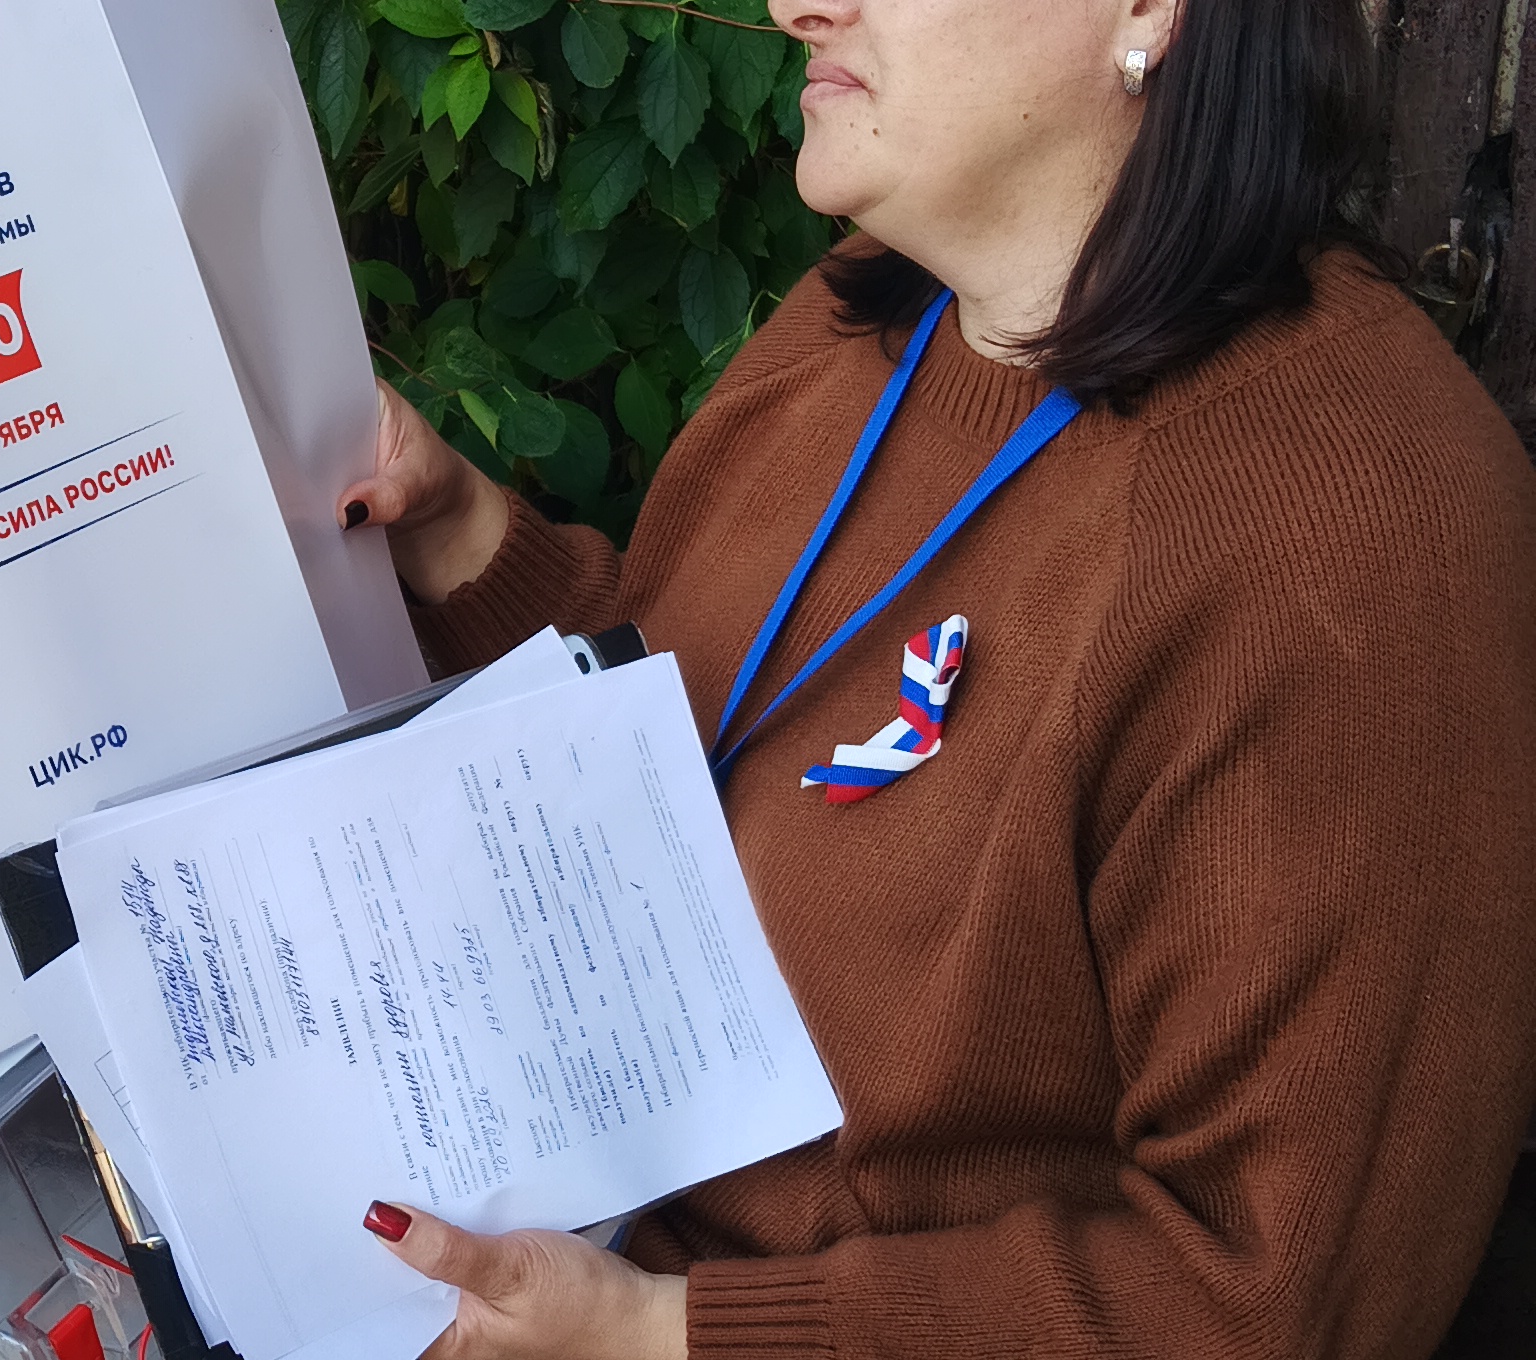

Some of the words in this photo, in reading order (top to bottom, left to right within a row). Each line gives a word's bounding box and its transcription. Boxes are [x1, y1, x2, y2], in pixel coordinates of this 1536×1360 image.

[65, 444, 175, 509] РОССИИ!
[29, 723, 129, 788] ЦИК.РФ
[516, 747, 532, 781] округу
[456, 765, 479, 813] депутатов
[467, 762, 489, 815] Федерации
[365, 815, 378, 834] для
[502, 799, 518, 833] округу
[307, 835, 317, 849] по
[475, 820, 494, 860] выборах
[486, 823, 511, 878] Российской
[534, 802, 565, 881] избирательному
[311, 850, 337, 911] голосования
[373, 838, 397, 893] помещения
[491, 867, 501, 880] на
[517, 843, 548, 922] избирательному
[581, 847, 599, 888] членами
[331, 911, 344, 930] для
[393, 897, 405, 915] вне
[498, 887, 523, 946] голосования
[509, 886, 529, 933] Собрания
[594, 888, 620, 951] следующими
[143, 934, 164, 975] участка
[238, 950, 248, 964] по
[273, 945, 289, 970] (при
[401, 919, 430, 989] проголосовать
[567, 902, 597, 973] федеральному
[647, 911, 672, 969] голосования
[337, 932, 361, 987] помещение
[520, 953, 532, 970] для
[527, 941, 554, 1009] Федерального
[547, 932, 579, 1015] одномандатному
[615, 950, 631, 981] выдан
[666, 969, 679, 987] для
[242, 965, 269, 1034] находящегося
[280, 969, 302, 1015] телефона
[355, 988, 363, 996] в
[528, 977, 551, 1031] бюллетени
[597, 993, 608, 1007] по
[626, 981, 648, 1033] бюллетень
[156, 975, 188, 1053] избирательного
[294, 1015, 310, 1048] номер
[328, 996, 358, 1067] ЗАЯВЛЕНИЕ
[358, 997, 377, 1040] прибыть
[426, 993, 451, 1057] возможность
[552, 1017, 569, 1046] Думы
[577, 1024, 587, 1038] по
[264, 1034, 278, 1059] либо
[370, 1042, 383, 1066] могу
[609, 1027, 632, 1083] бюллетень
[681, 1014, 709, 1072] Переносной
[178, 1052, 195, 1080] УИК
[188, 1080, 199, 1091] В
[199, 1073, 209, 1086] от
[377, 1067, 388, 1080] не
[382, 1081, 390, 1089] я
[446, 1061, 458, 1081] мне
[548, 1038, 579, 1111] Избирательные
[577, 1055, 593, 1090] созыва
[586, 1046, 608, 1102] бюллетень
[642, 1033, 673, 1107] Избирательный
[385, 1090, 396, 1109] что
[470, 1095, 483, 1114] дни
[565, 1054, 599, 1137] Государственной
[589, 1090, 609, 1132] девятого
[455, 1085, 481, 1151] предоставить
[476, 1115, 485, 1123] в
[526, 1117, 545, 1159] Паспорт
[400, 1141, 415, 1169] связи
[476, 1156, 492, 1188] прошу
[479, 1123, 503, 1184] голосования
[407, 1170, 419, 1181] В
[420, 1164, 440, 1206] причине
